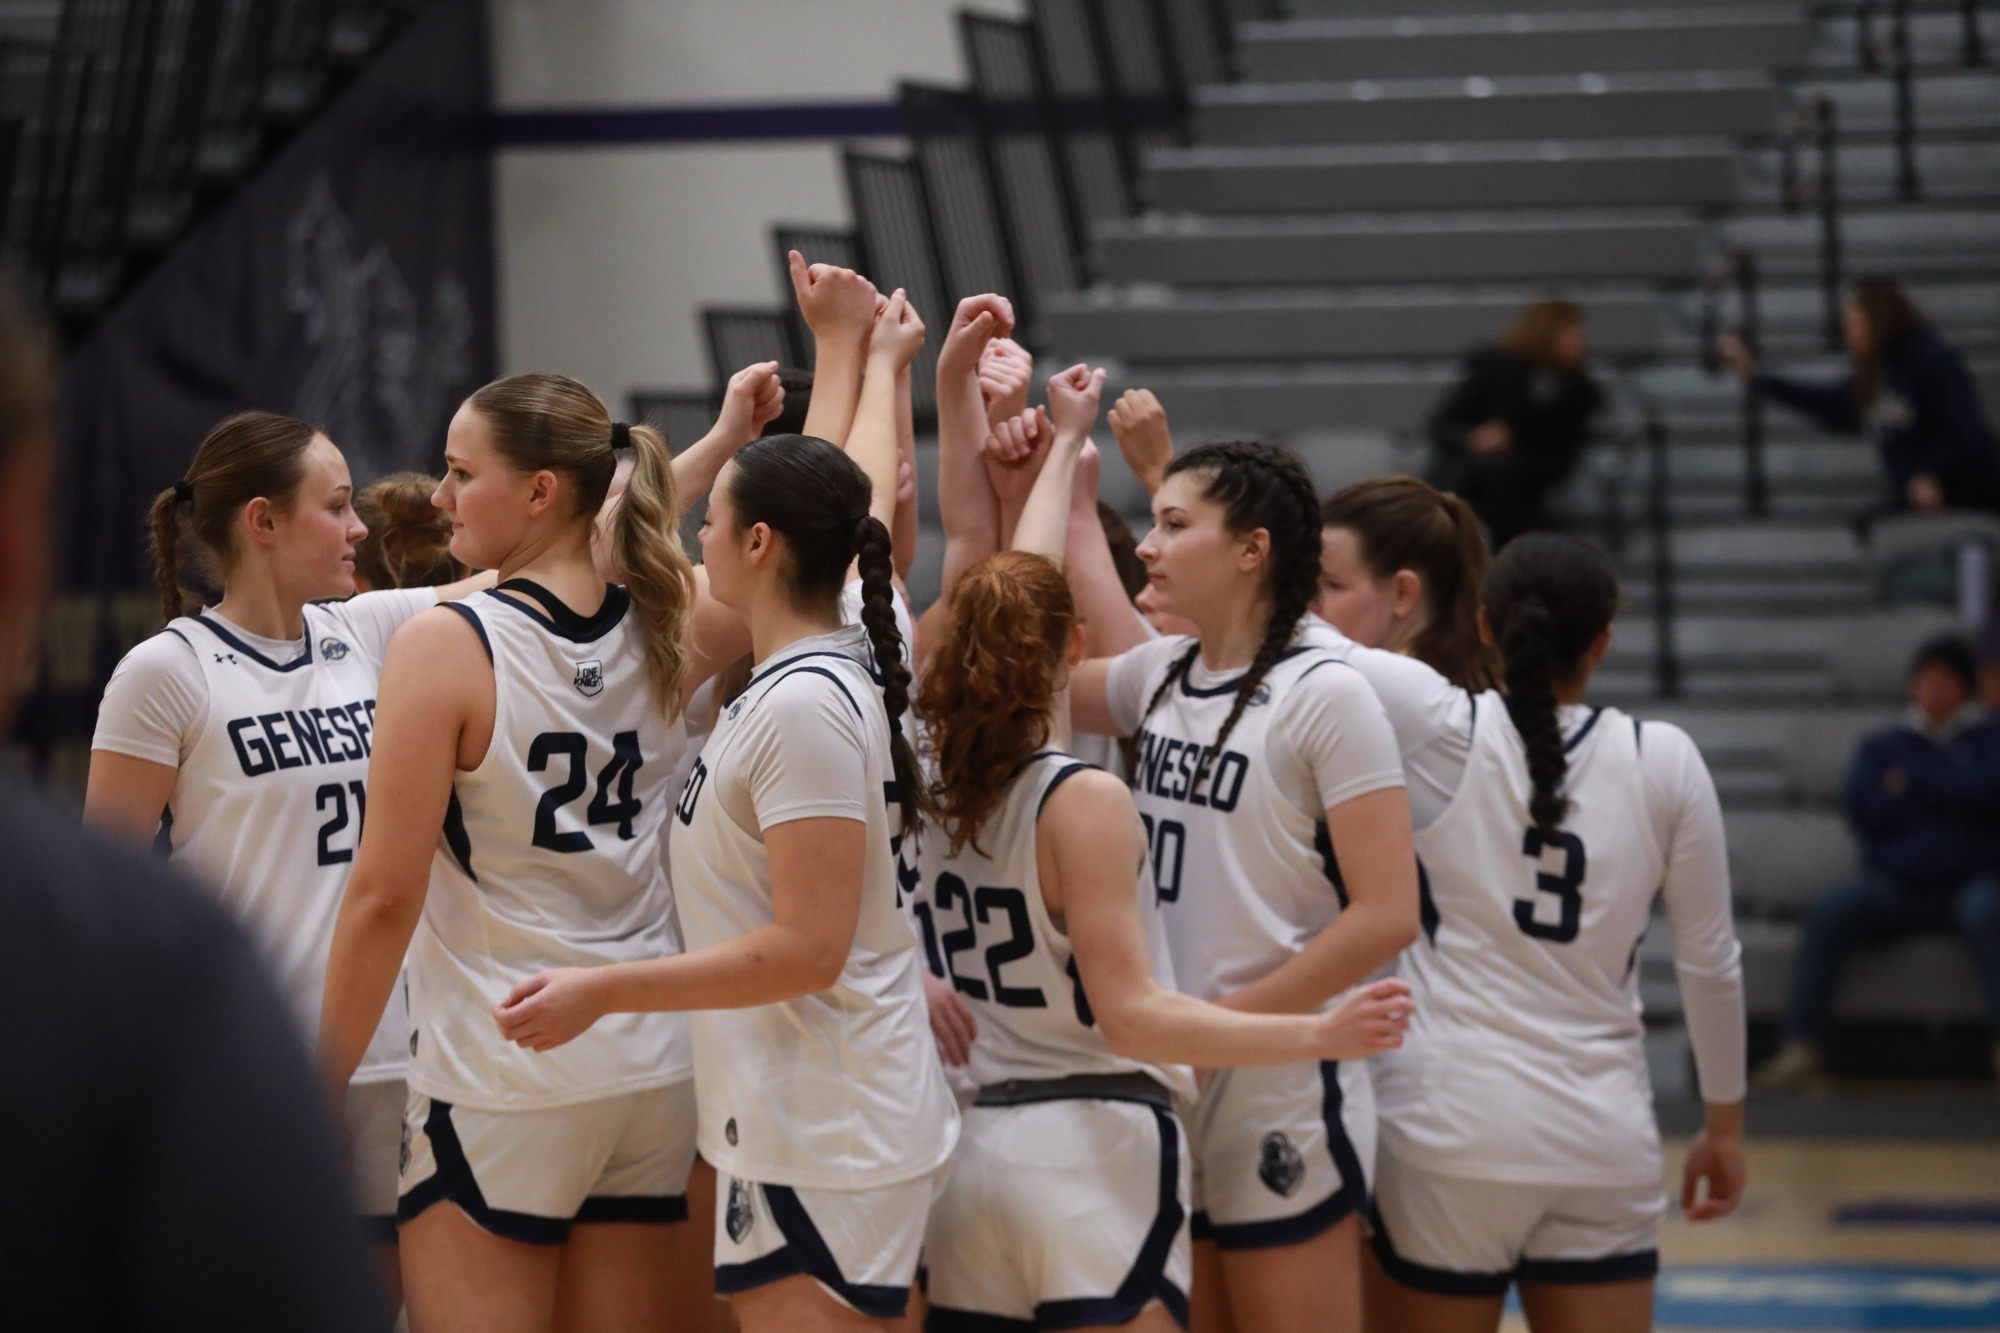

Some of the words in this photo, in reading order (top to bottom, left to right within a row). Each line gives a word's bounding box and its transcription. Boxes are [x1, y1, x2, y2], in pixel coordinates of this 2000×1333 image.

[527, 730, 643, 853] 24
[935, 871, 1047, 1008] 22
[1512, 826, 1586, 944] 3
